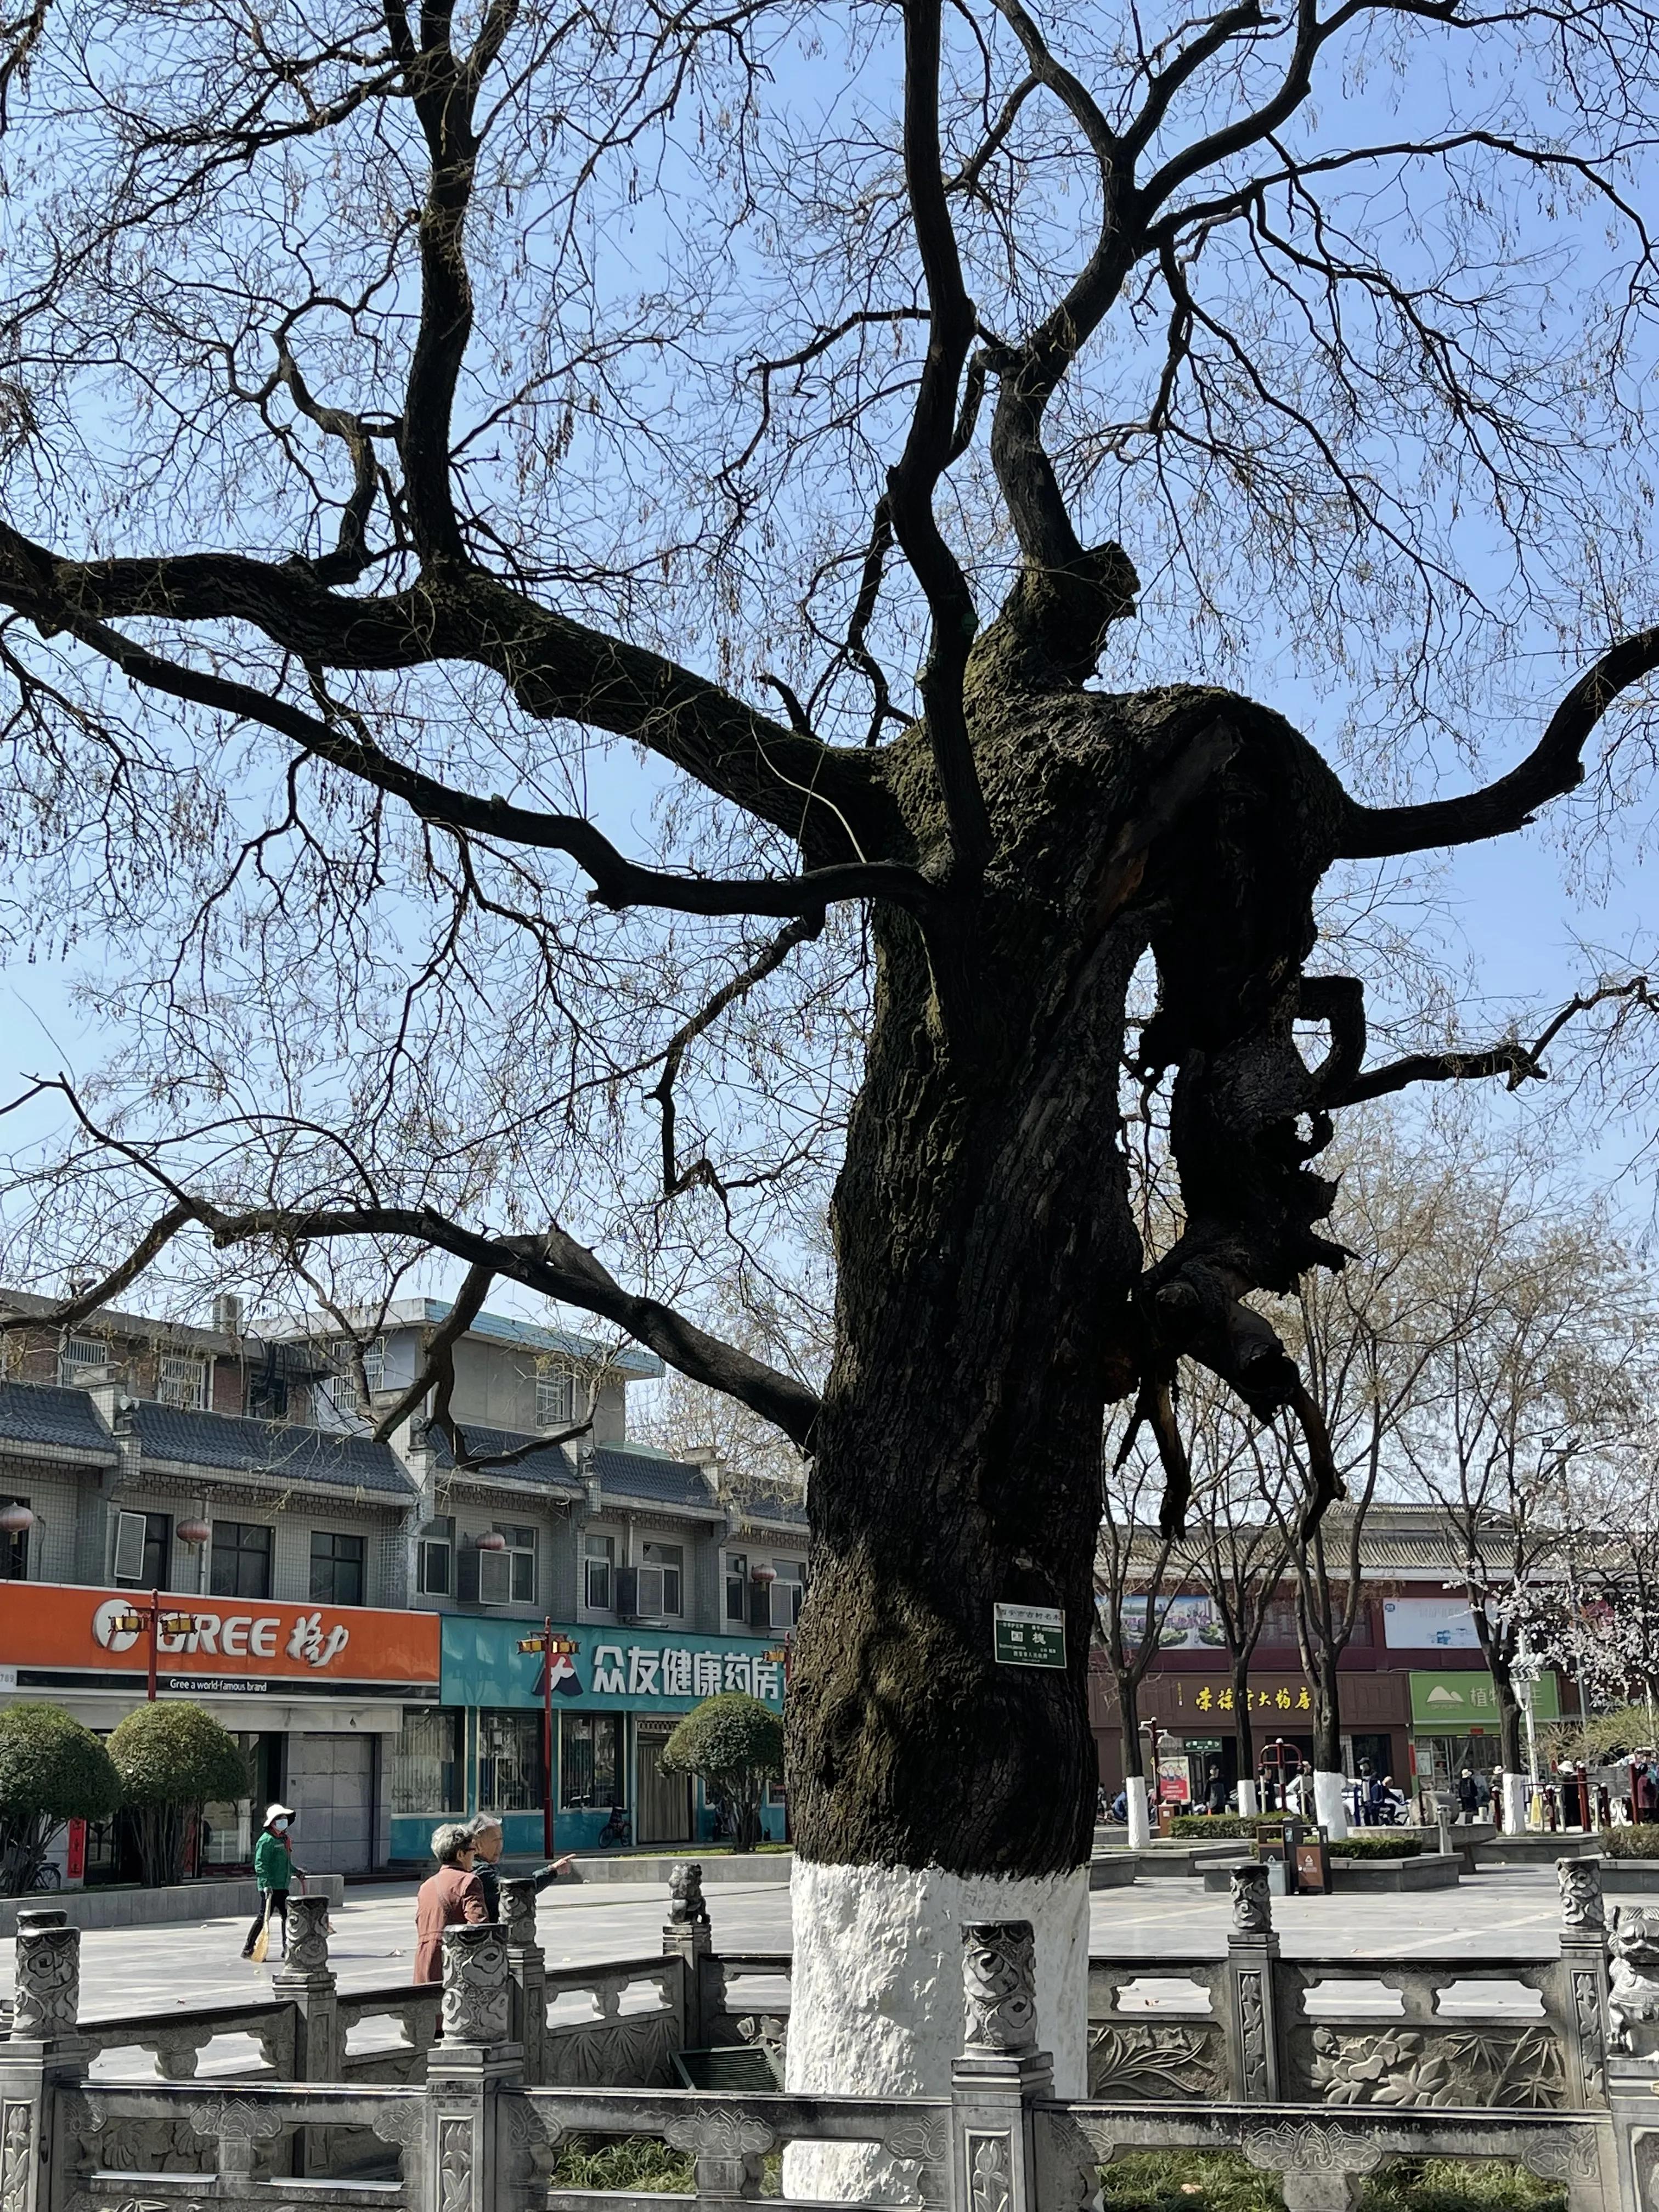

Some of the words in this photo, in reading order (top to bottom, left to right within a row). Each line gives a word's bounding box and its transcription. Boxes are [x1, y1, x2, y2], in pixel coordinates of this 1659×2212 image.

[156, 1612, 280, 1657] GREE
[170, 1679, 189, 1689] Gree
[197, 1680, 246, 1691] world-famous
[247, 1681, 267, 1691] brand
[592, 1645, 786, 1700] 众友健康药房
